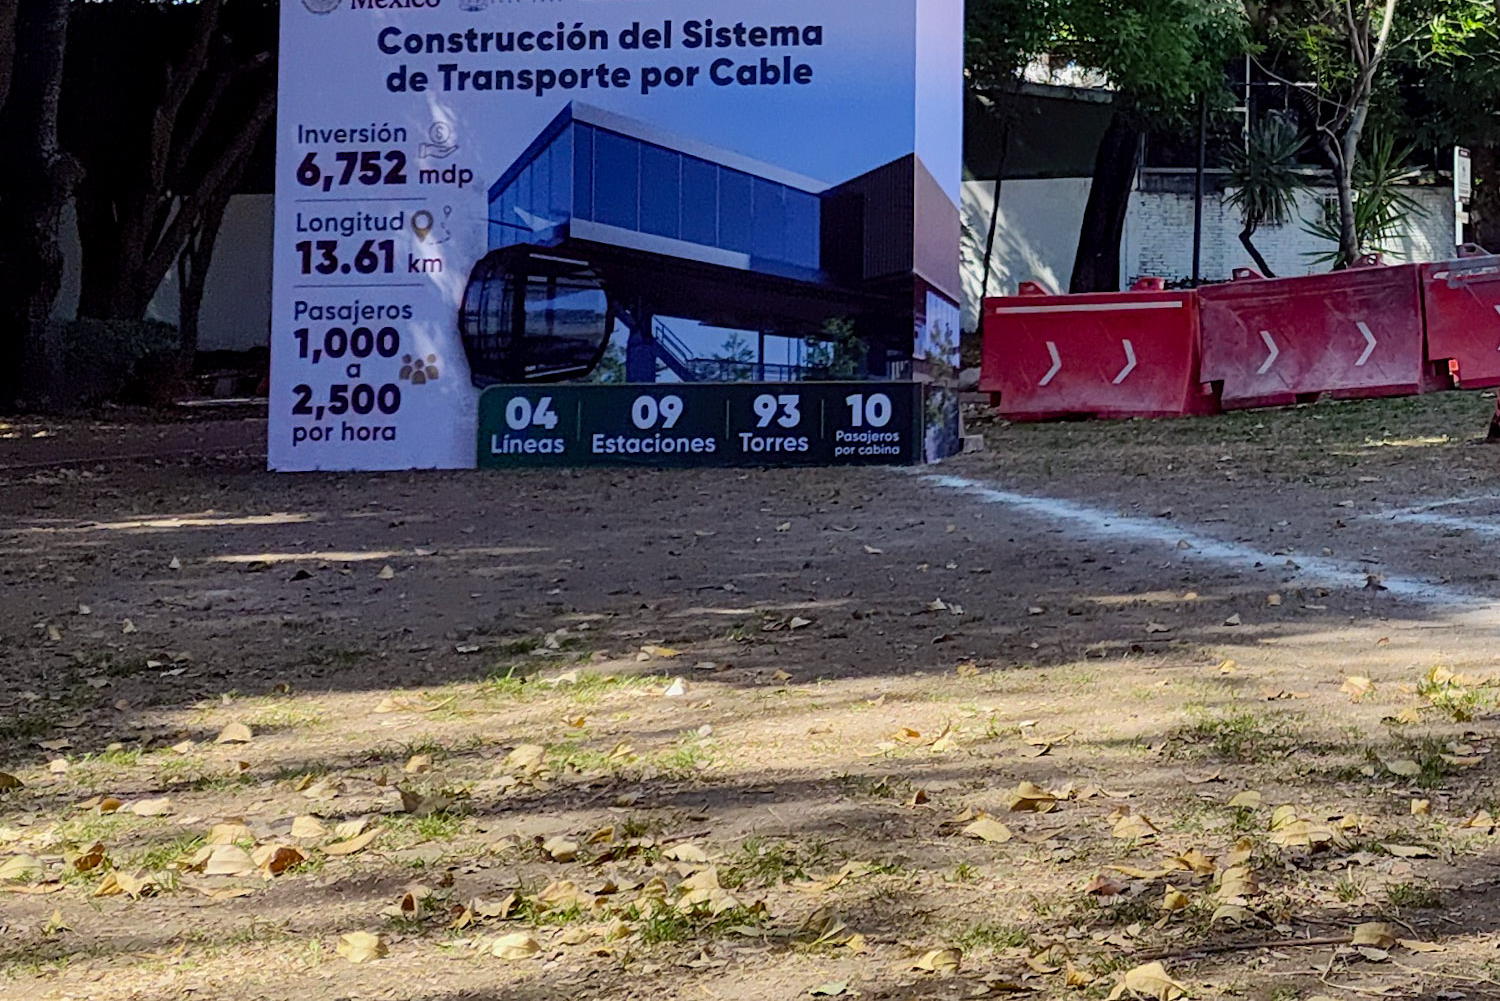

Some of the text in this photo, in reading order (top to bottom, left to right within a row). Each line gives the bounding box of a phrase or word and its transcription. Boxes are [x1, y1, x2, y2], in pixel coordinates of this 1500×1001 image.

[377, 18, 823, 55] Construcción del Sistema
[386, 55, 813, 97] de Transporte por Cable
[298, 123, 407, 144] Inversión
[296, 150, 473, 192] 6,752 mdp
[296, 211, 404, 237] Longitud
[295, 239, 443, 275] 13.61 km
[294, 300, 413, 325] Pasajeros
[293, 326, 400, 364] 1,000
[346, 363, 361, 378] a
[292, 383, 401, 421] 2,500
[505, 396, 558, 430] 04
[632, 395, 684, 430] 09
[753, 394, 801, 428] 93
[845, 393, 892, 427] 10
[293, 421, 396, 446] por hora
[491, 433, 565, 454] Líneas
[592, 433, 716, 453] Estaciones
[738, 432, 809, 452] Torres
[835, 430, 900, 444] Pasajeros
[835, 444, 900, 457] por cabina
